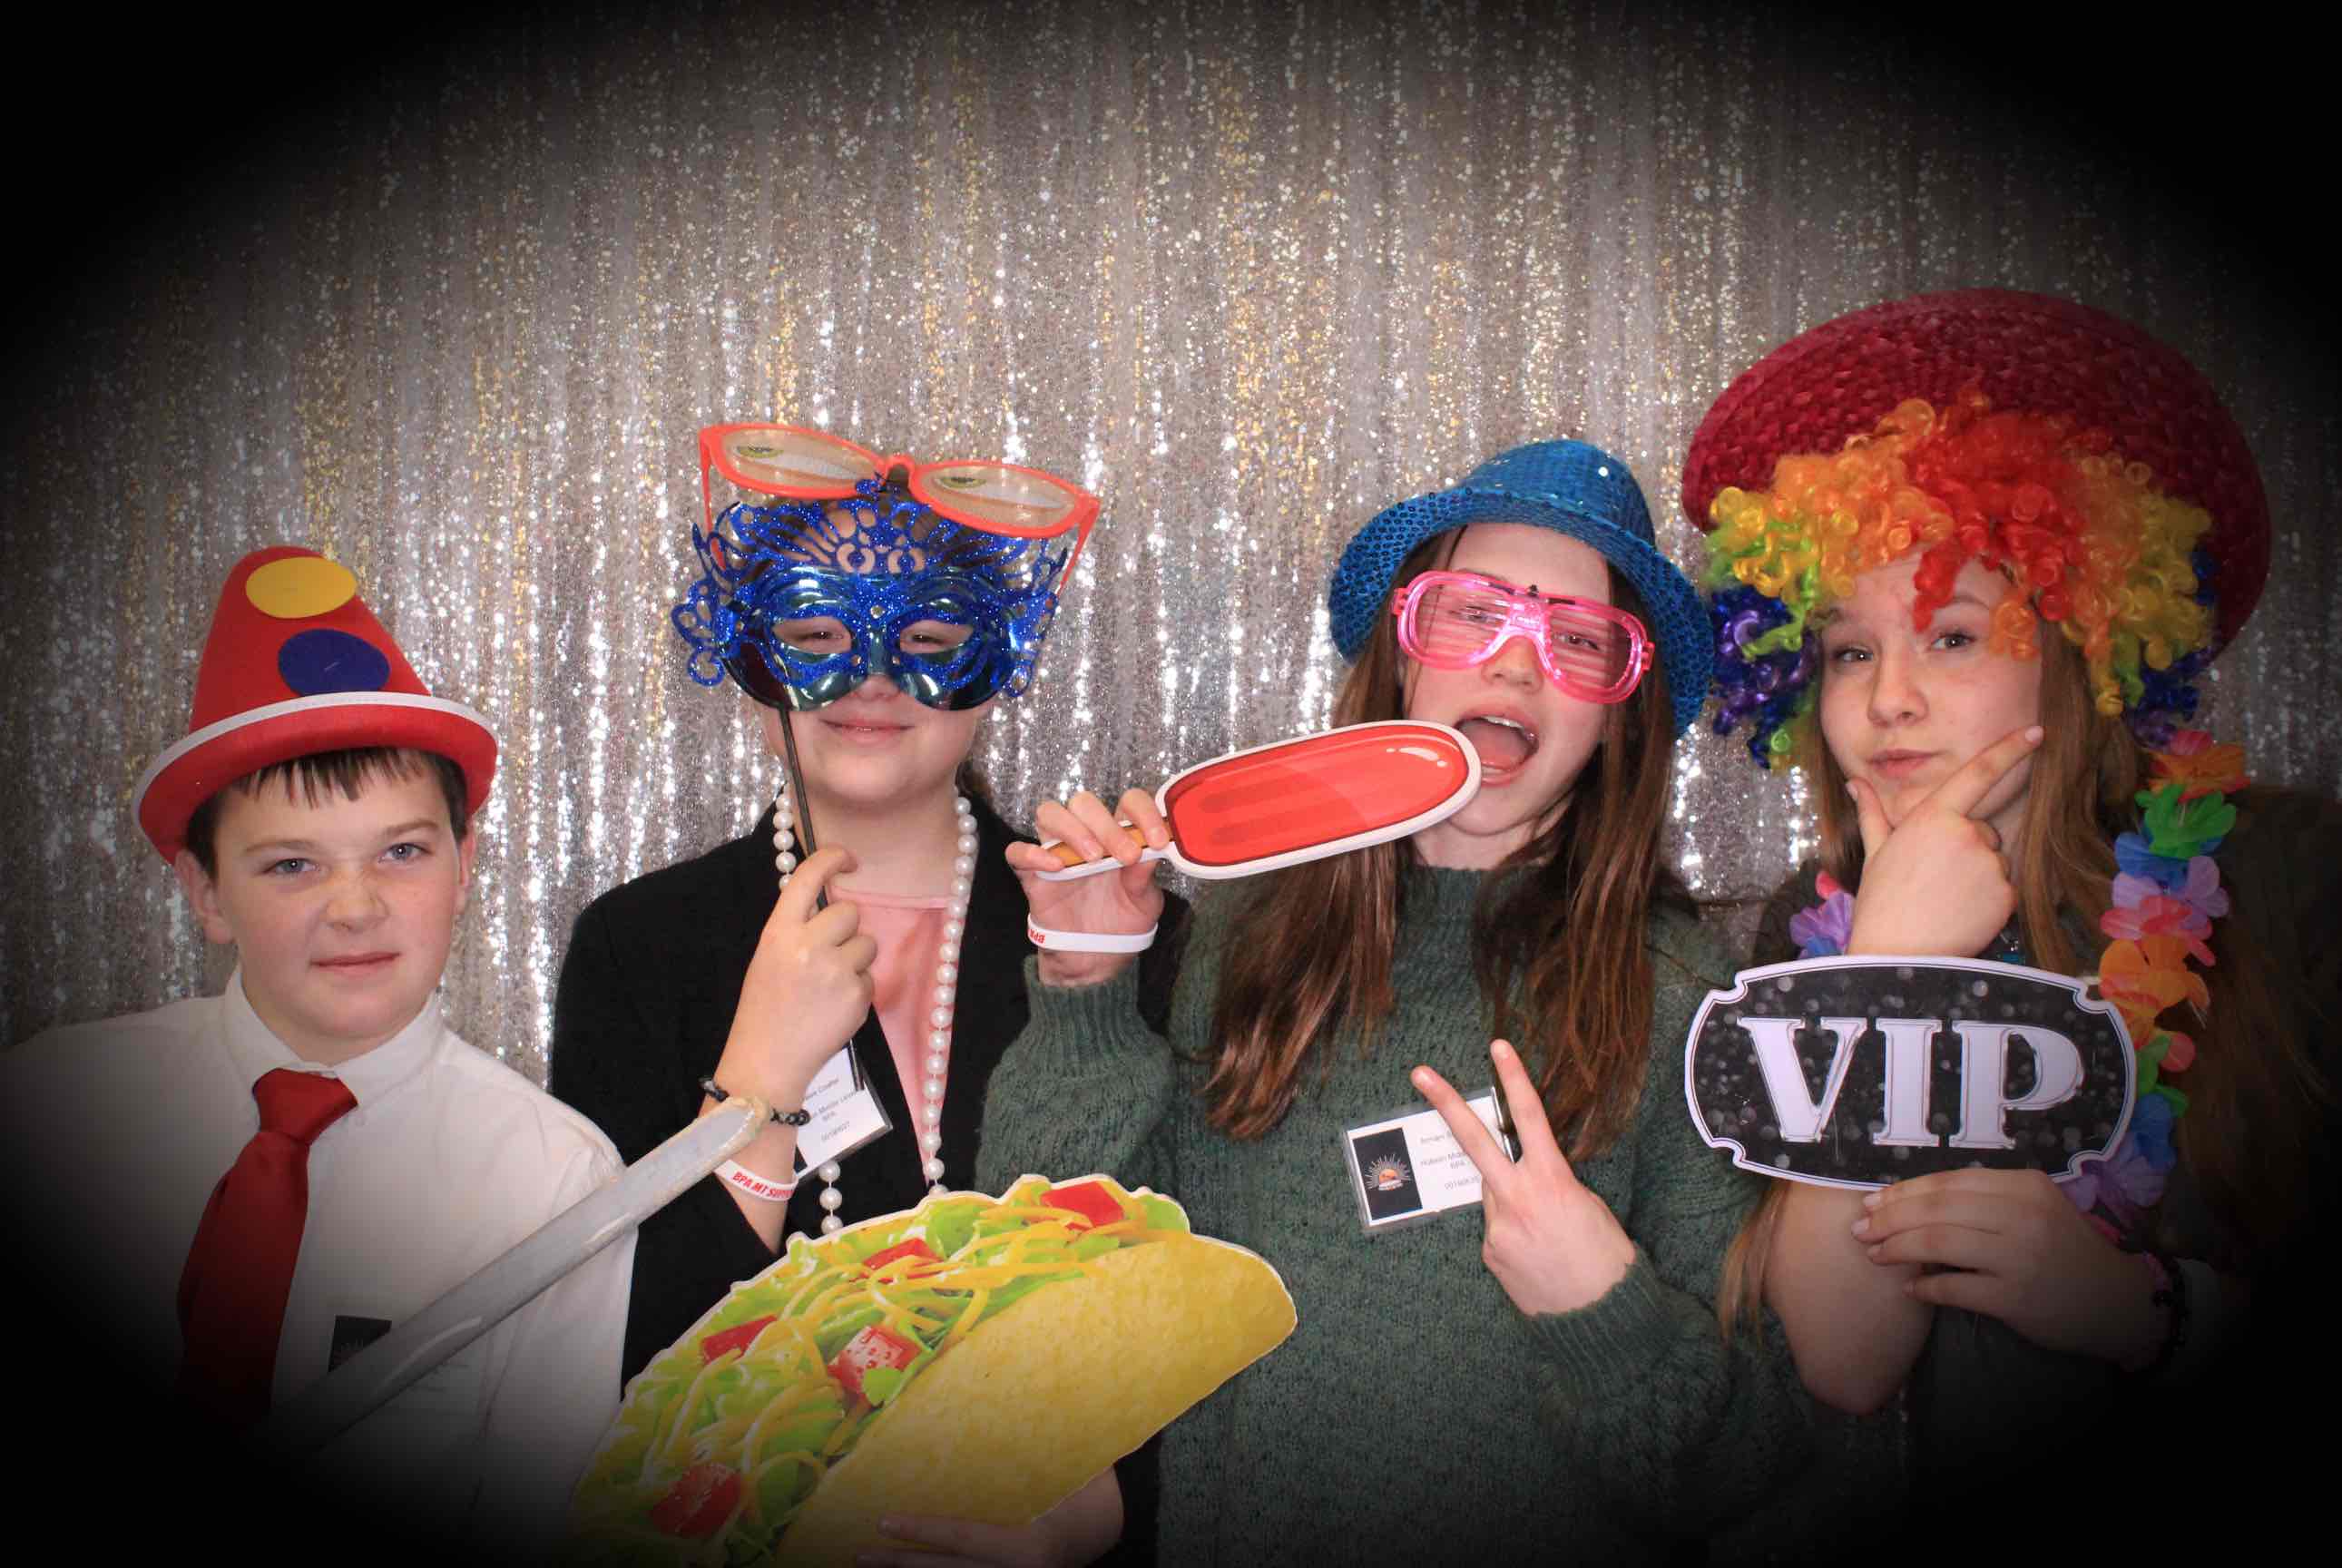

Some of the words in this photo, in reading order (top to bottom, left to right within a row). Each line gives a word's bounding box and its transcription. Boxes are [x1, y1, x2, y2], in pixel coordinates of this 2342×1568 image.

[1737, 1016, 2083, 1149] VIP
[732, 1171, 752, 1188] BPA
[752, 1182, 769, 1195] MT
